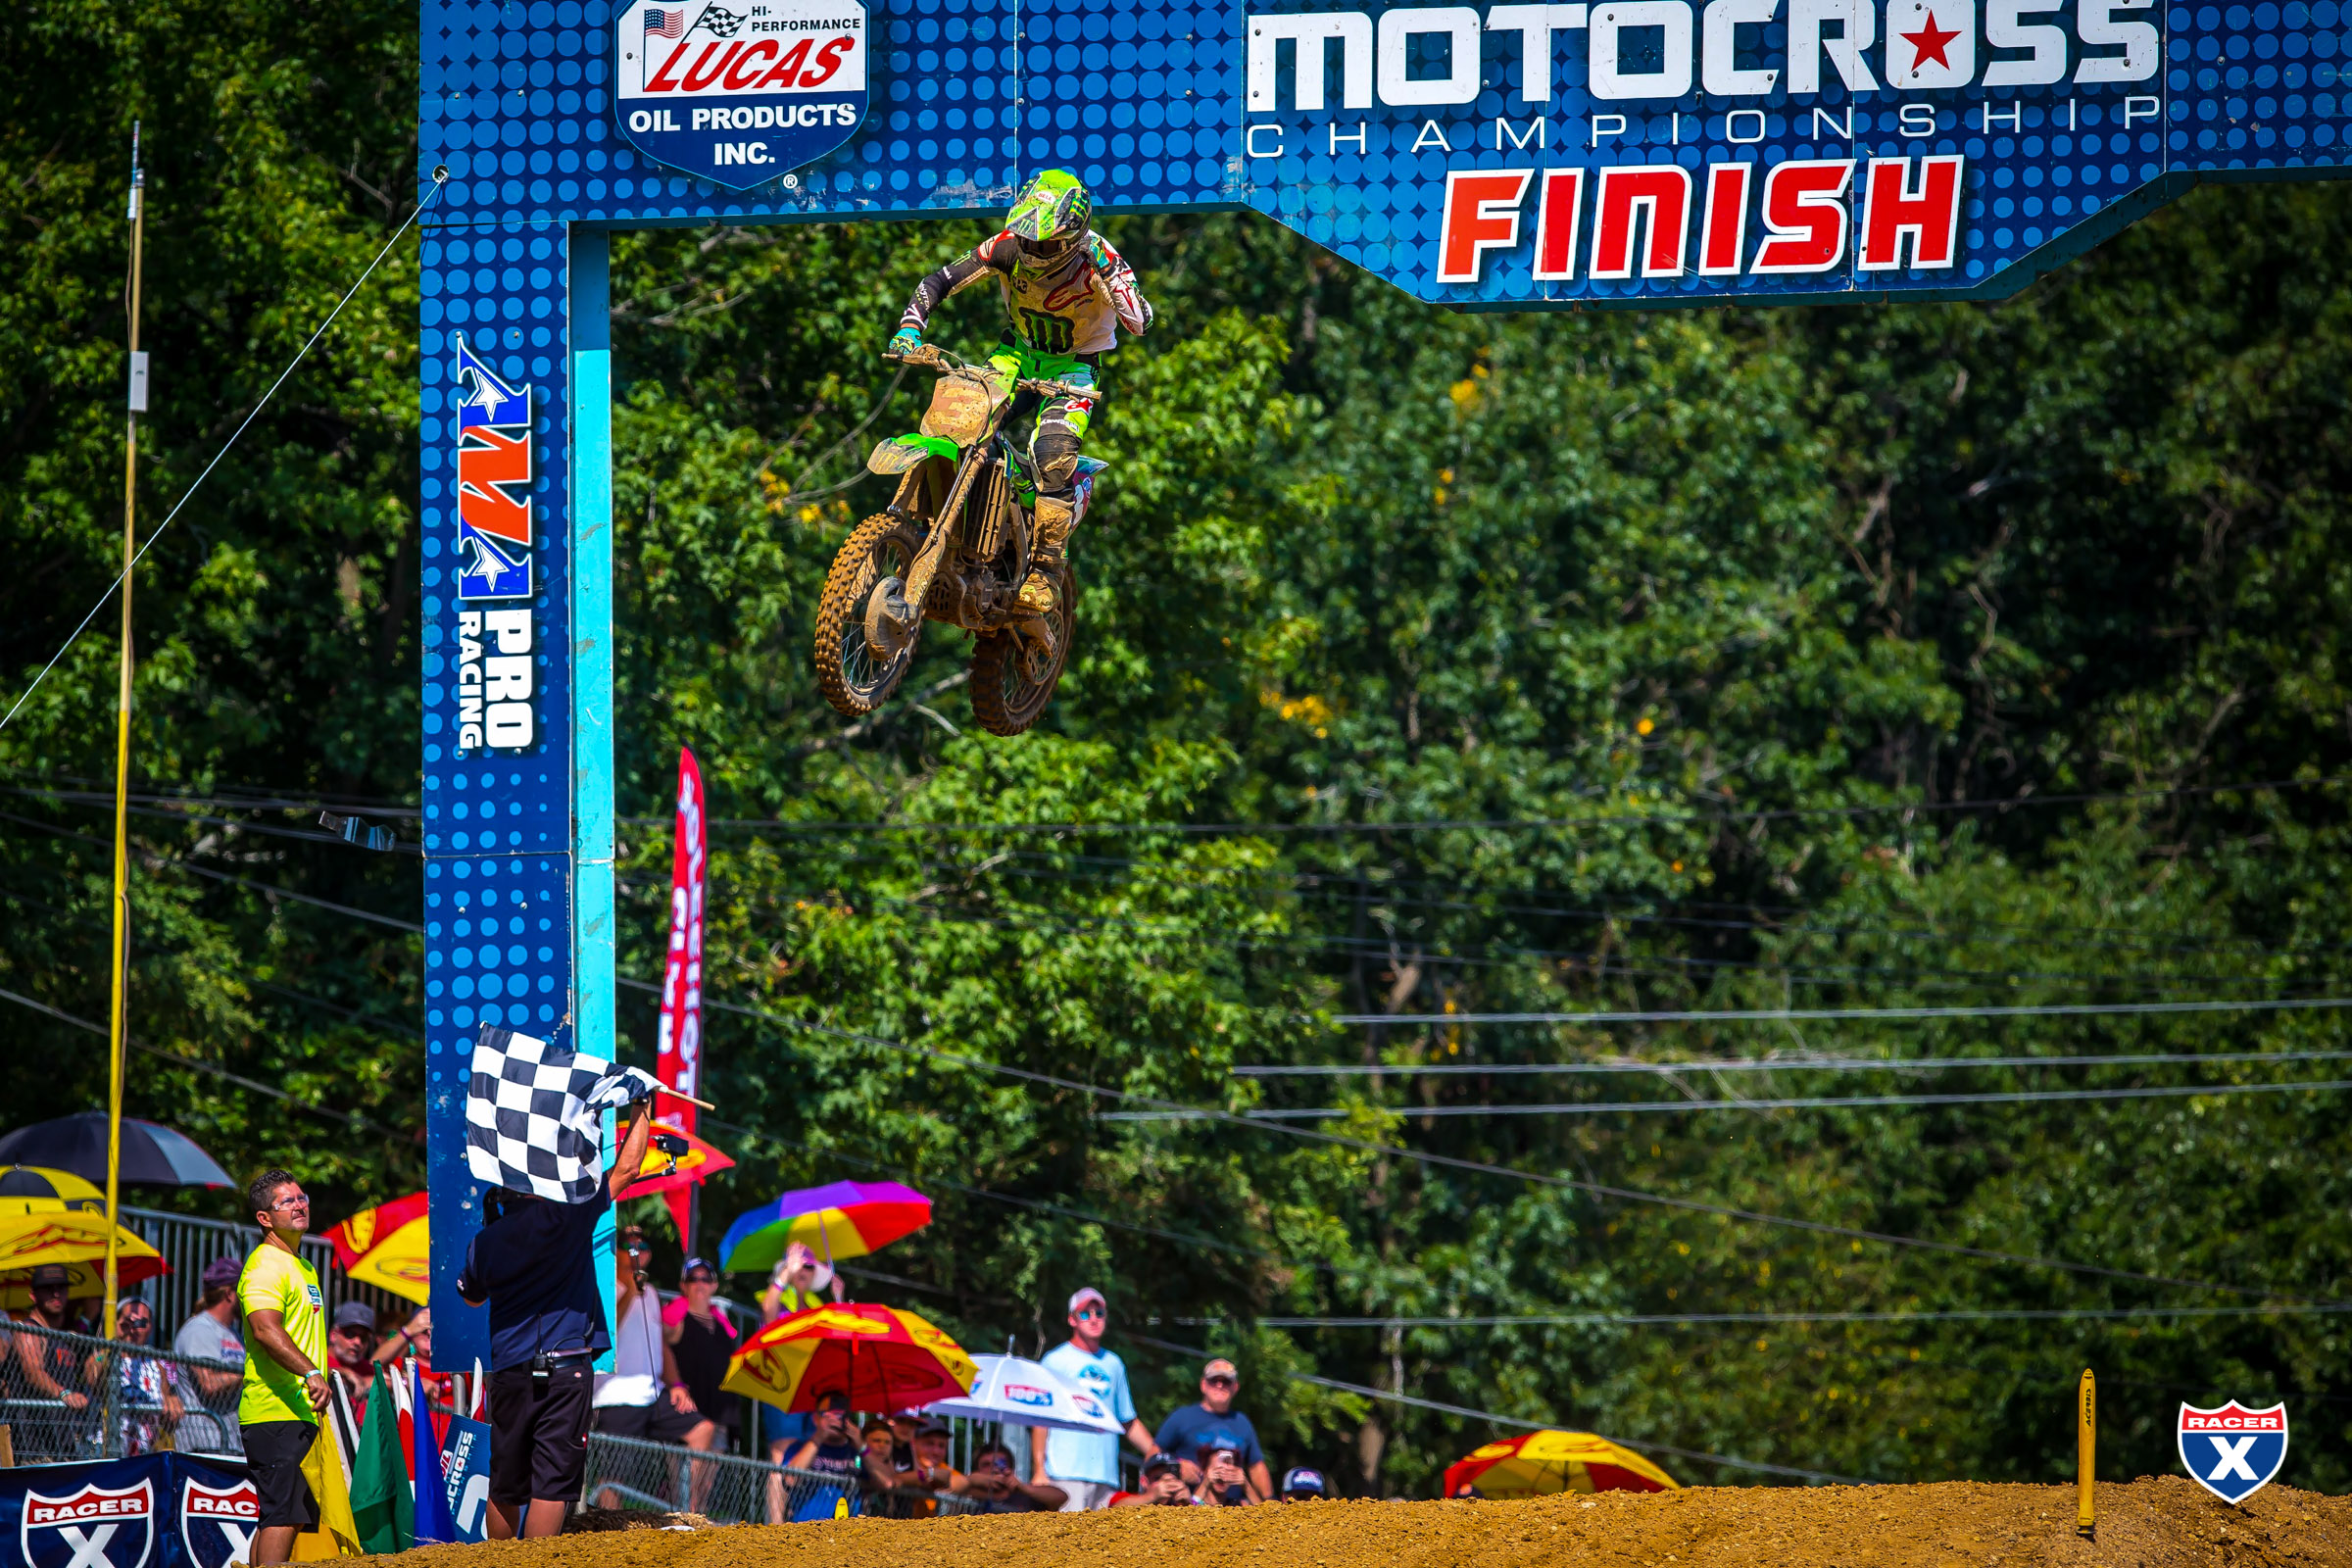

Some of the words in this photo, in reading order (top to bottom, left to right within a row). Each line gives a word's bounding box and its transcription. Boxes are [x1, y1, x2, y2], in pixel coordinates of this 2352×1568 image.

[751, 5, 772, 17] HI-
[751, 18, 861, 32] PERFORMANCE
[643, 36, 856, 92] LUCAS
[1246, 0, 2159, 113] MOTOCROSS
[628, 110, 681, 132] OIL
[692, 103, 857, 130] PRODUCTS
[1246, 95, 2160, 159] CHAMPIONSHIP
[713, 143, 775, 165] INC.
[1436, 154, 1964, 283] FINISH
[458, 332, 531, 600] AMA
[459, 611, 483, 749] RACING
[485, 609, 533, 749] PRO
[33, 1497, 143, 1522] RACER
[193, 1496, 259, 1516] RAC
[57, 1524, 120, 1568] X
